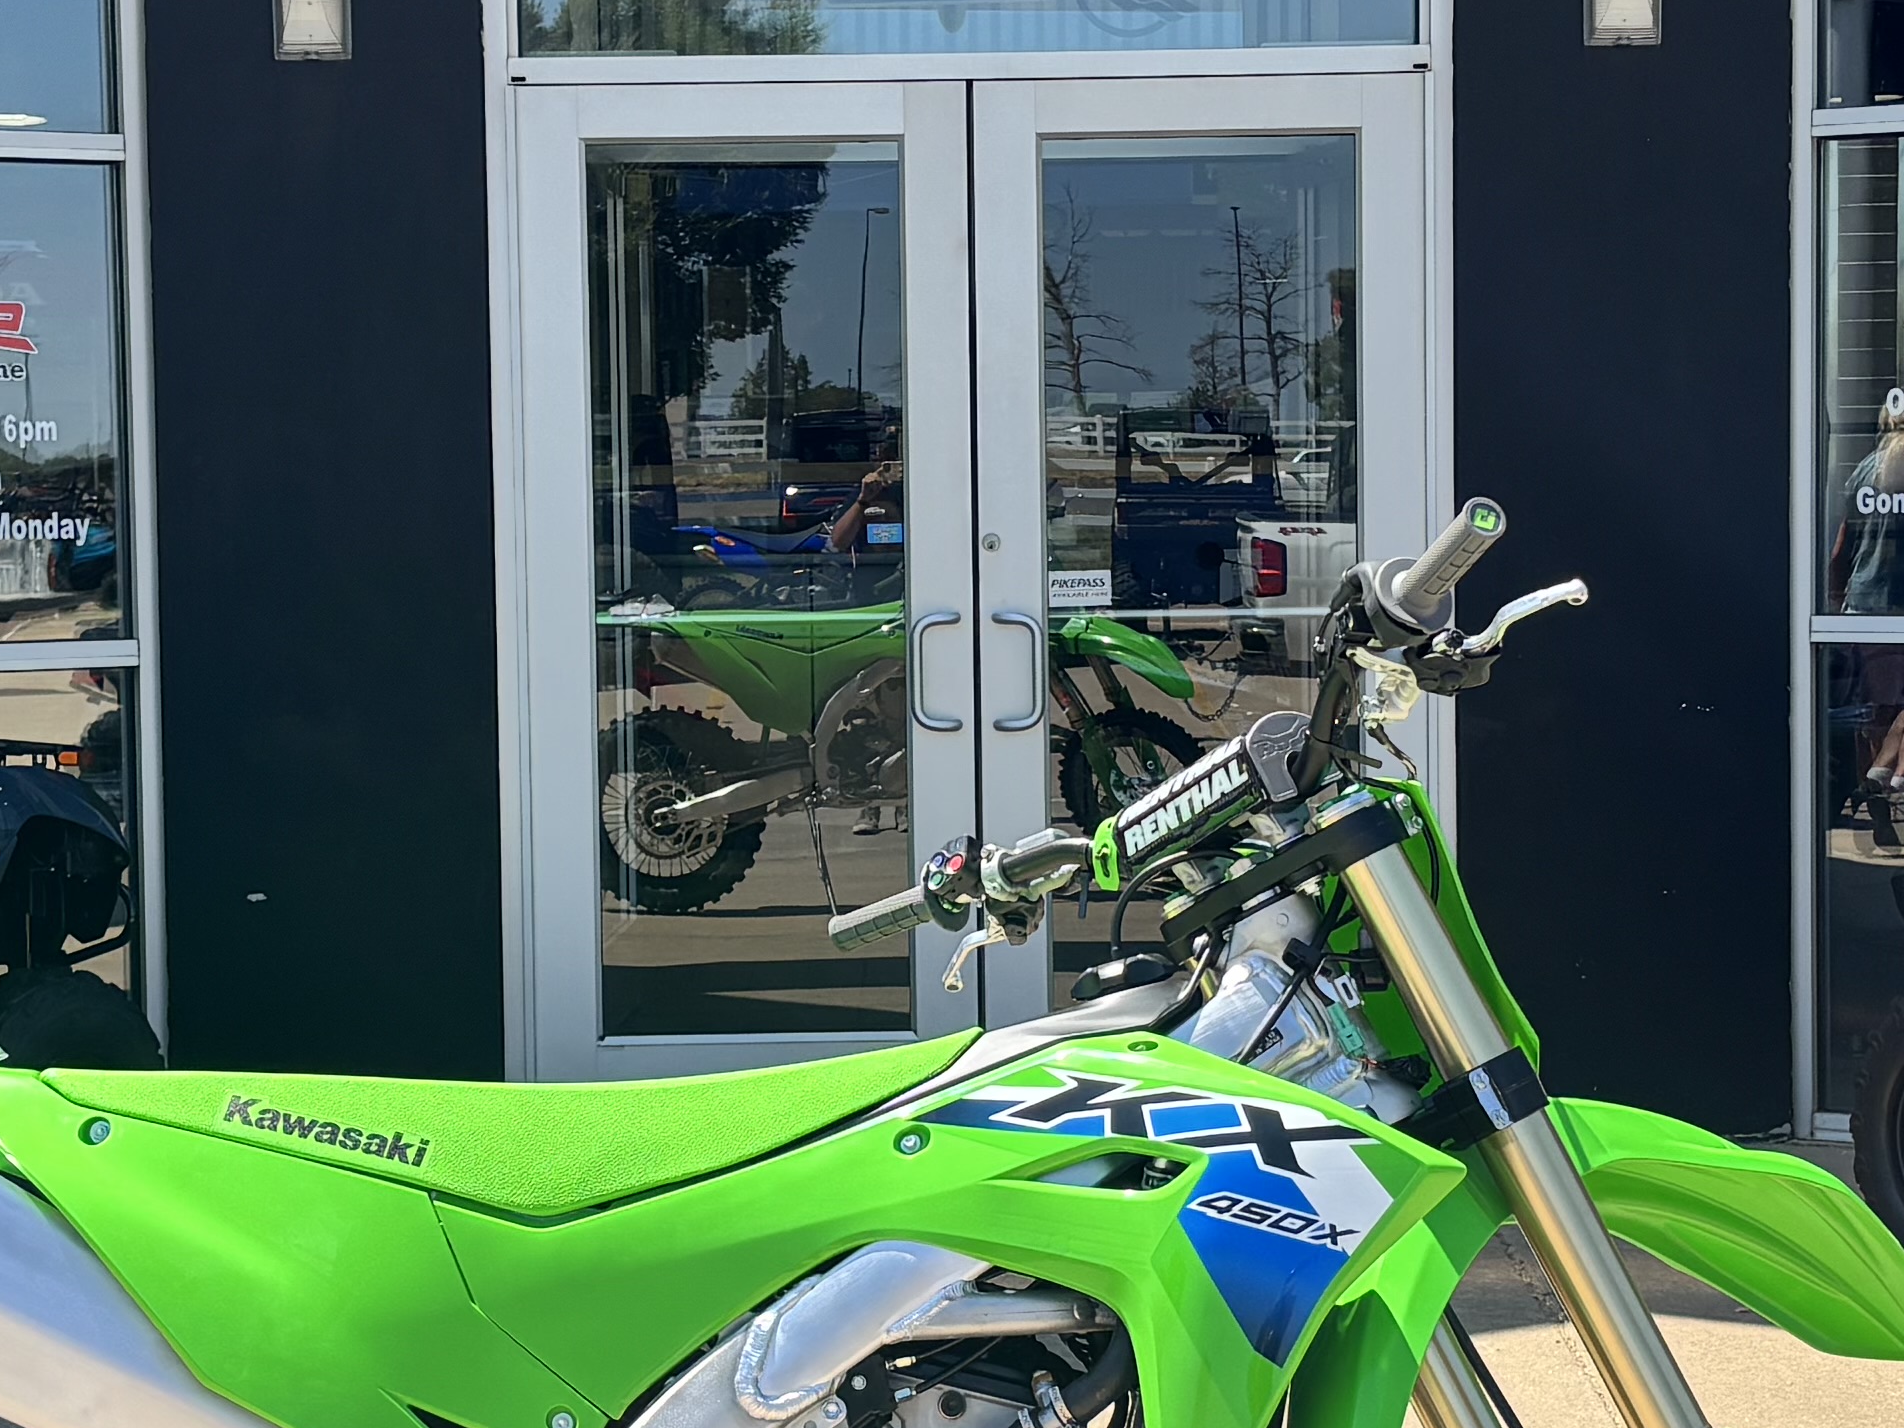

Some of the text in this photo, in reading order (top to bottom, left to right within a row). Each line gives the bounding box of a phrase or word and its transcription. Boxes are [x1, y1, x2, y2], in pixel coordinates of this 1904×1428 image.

[1124, 759, 1248, 858] RENTHAL
[223, 1094, 431, 1168] Kawasaki
[1001, 1074, 1379, 1181] KX
